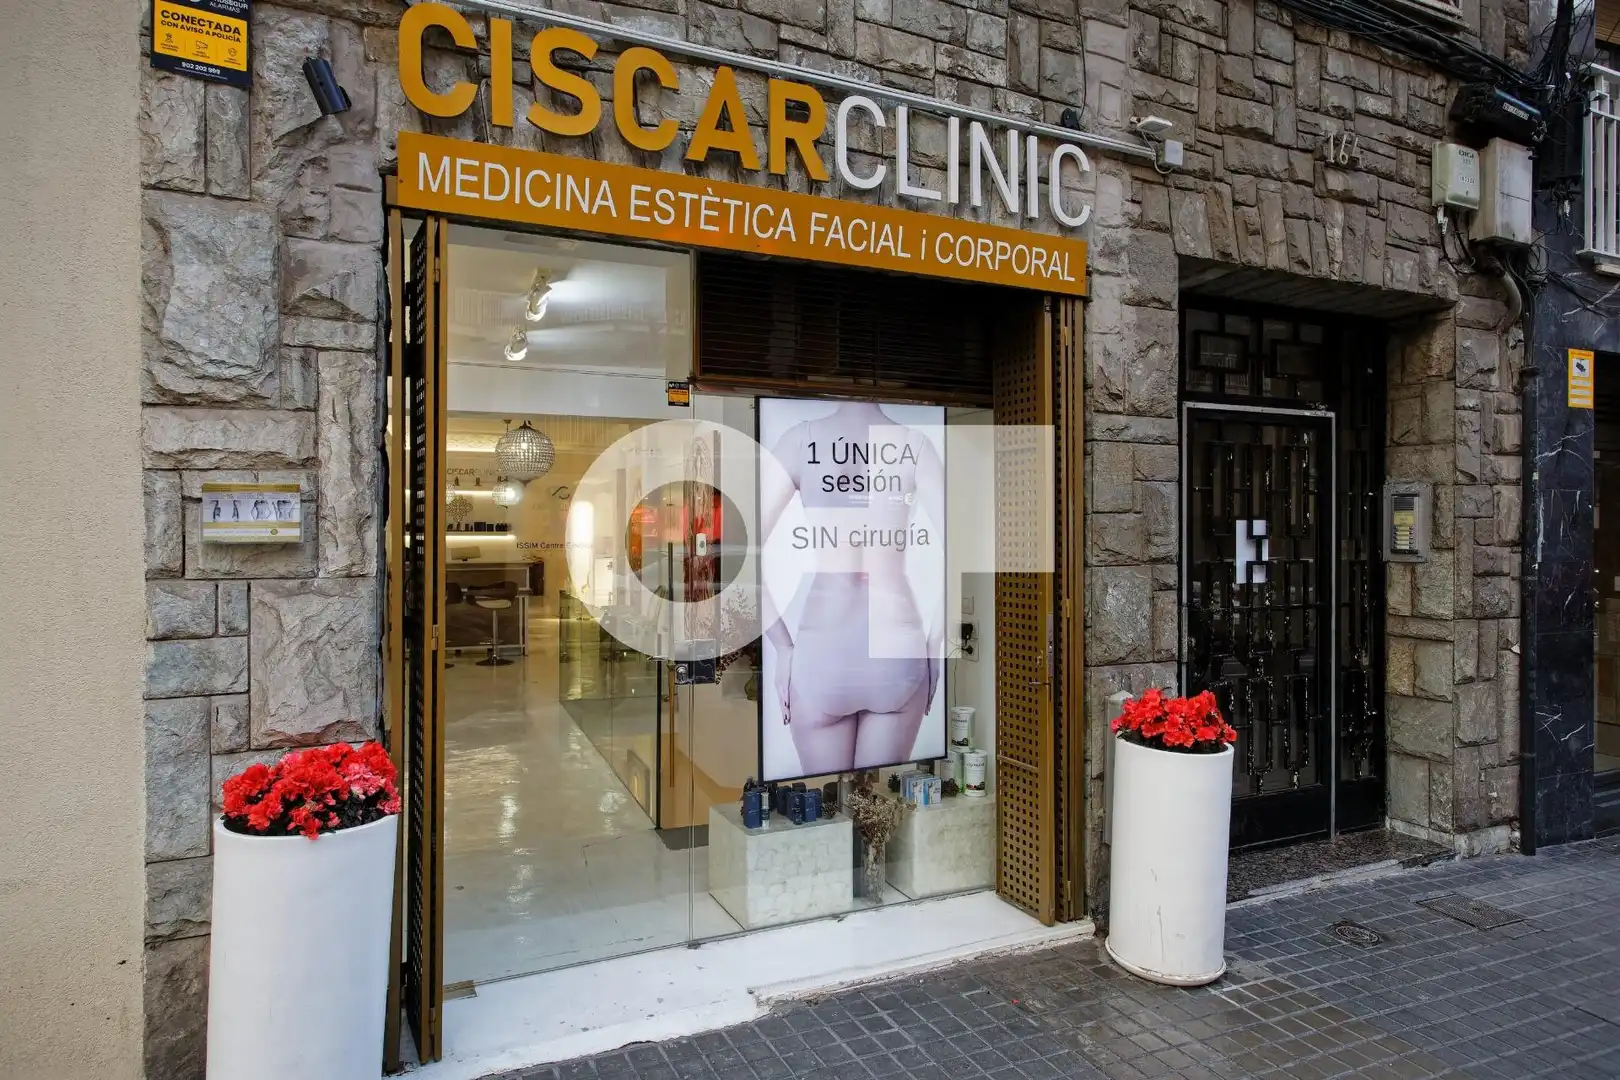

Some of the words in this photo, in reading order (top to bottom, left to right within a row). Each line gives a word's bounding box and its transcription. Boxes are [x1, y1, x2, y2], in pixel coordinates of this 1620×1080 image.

[209, 2, 241, 14] ALARMAS
[160, 9, 241, 36] CONECTADA
[160, 20, 179, 29] CON
[179, 25, 204, 35] AVISO
[211, 31, 242, 43] POLICÍA
[181, 61, 194, 70] 902
[195, 64, 208, 72] 202
[398, 3, 1091, 228] CISCARCLINIC
[417, 151, 618, 218] MEDICINA
[629, 186, 797, 243] ESTÈTICA
[808, 211, 912, 259] FACIAL
[919, 228, 928, 261] i
[934, 231, 1076, 283] CORPORAL
[806, 441, 821, 465] 1
[831, 436, 918, 465] ÚNICA
[821, 469, 902, 493] sesión
[540, 542, 564, 550] Centre
[791, 525, 838, 549] SIN
[848, 522, 931, 551] cirugía
